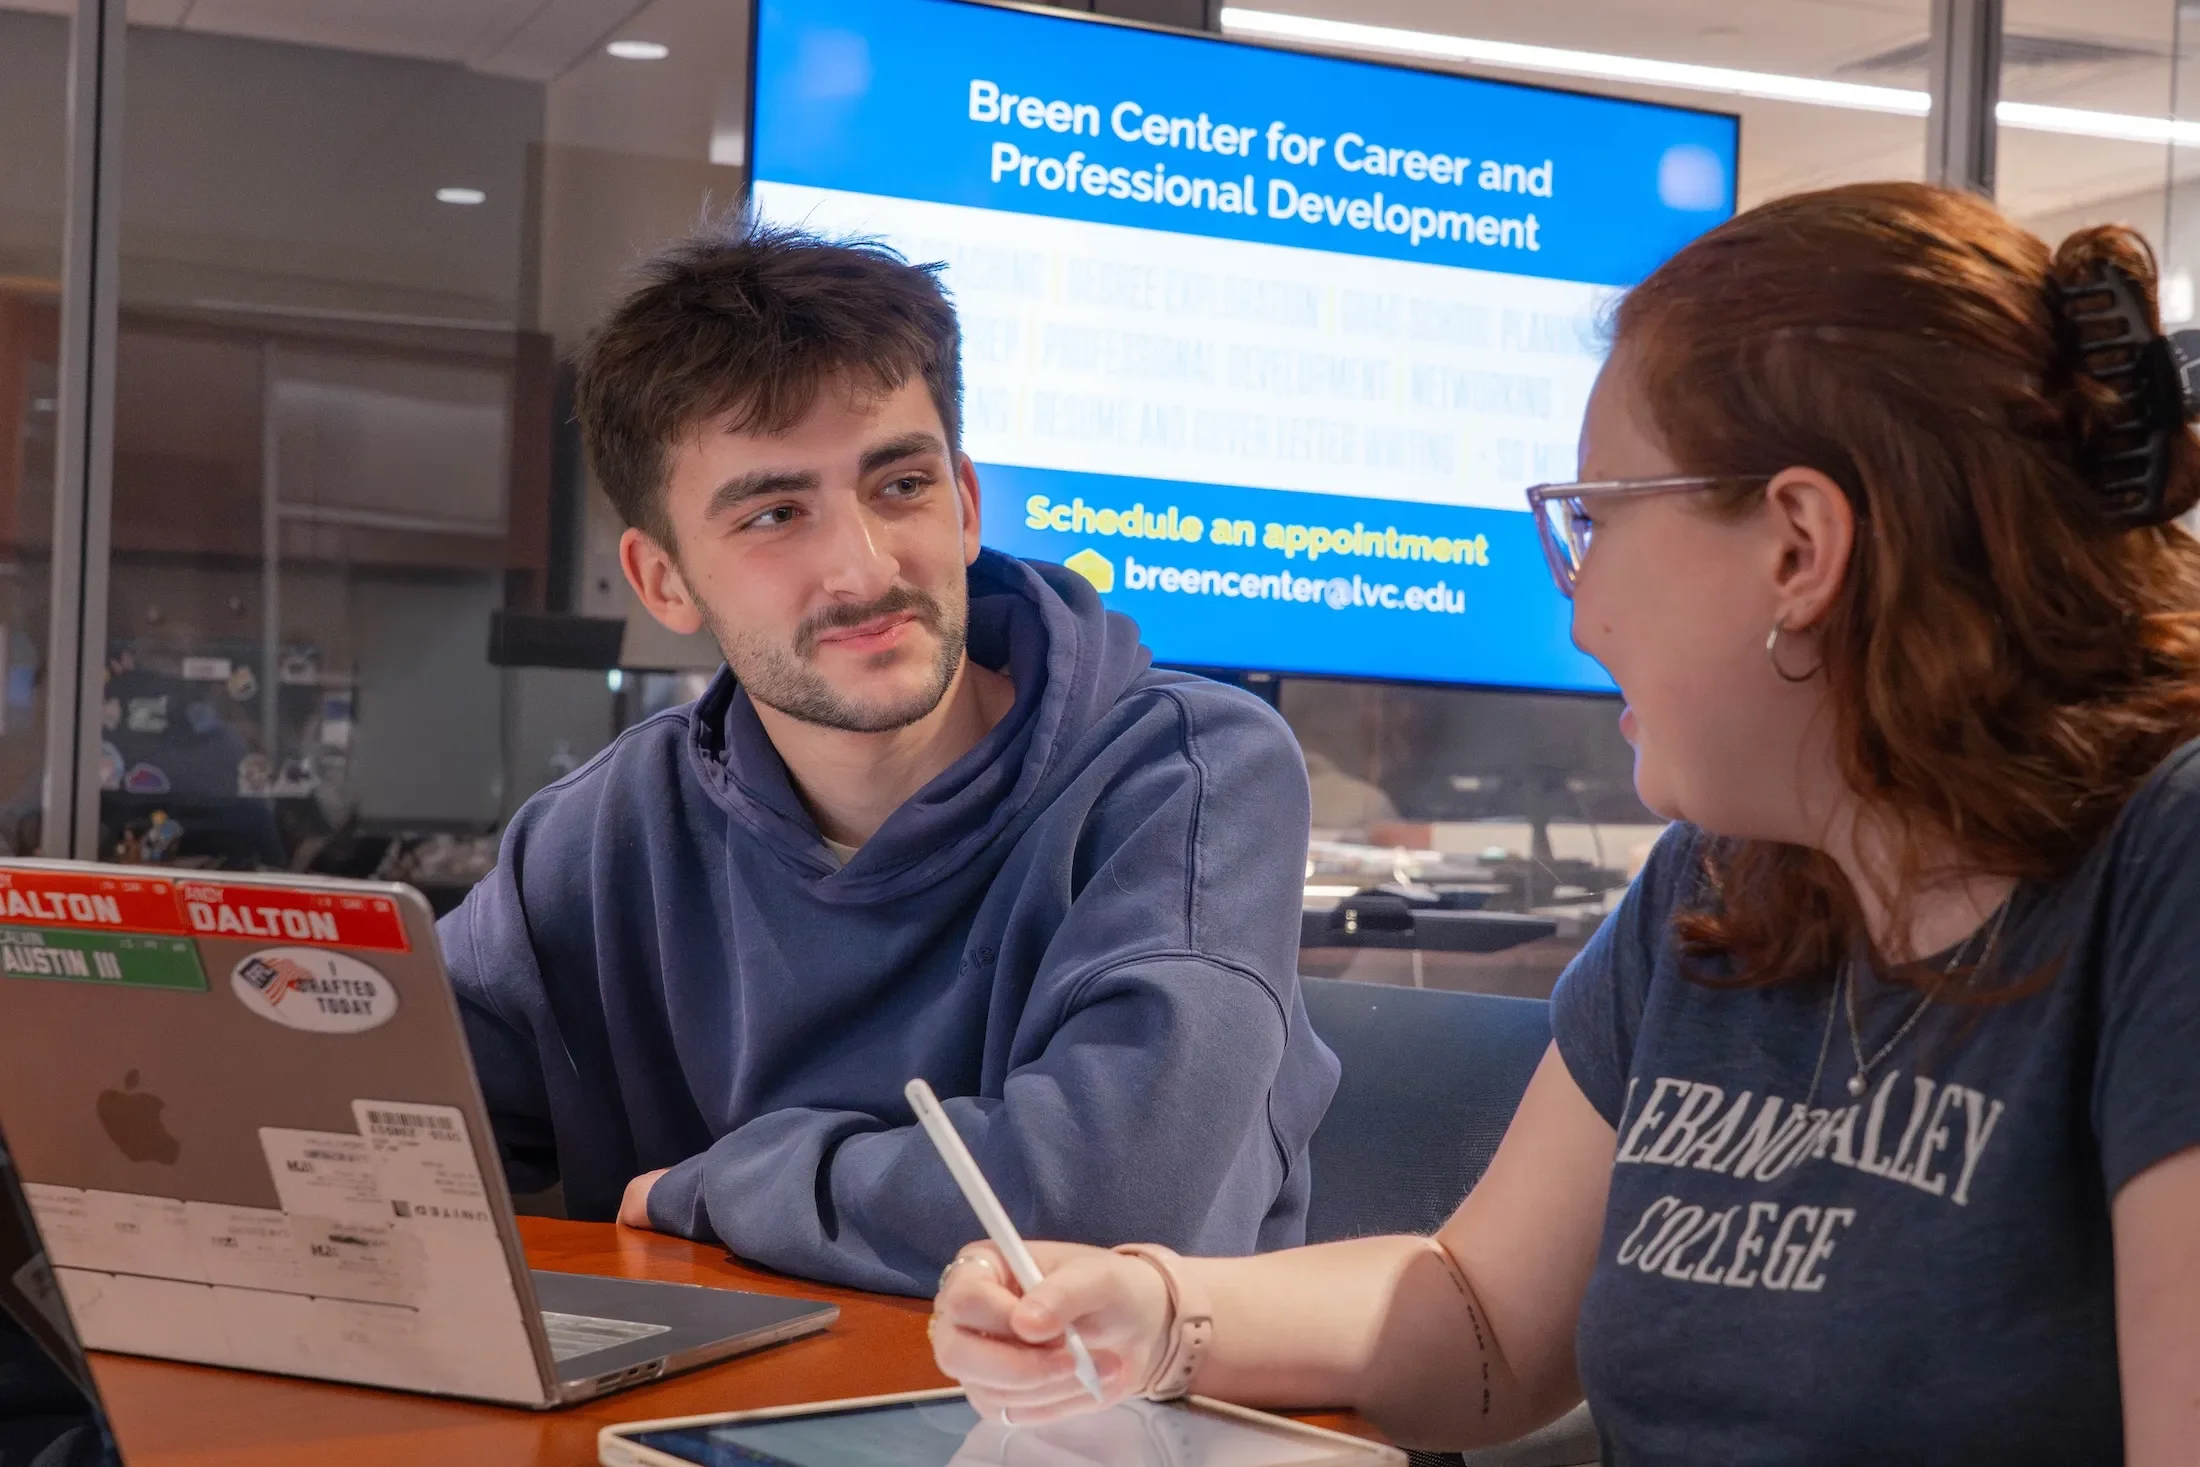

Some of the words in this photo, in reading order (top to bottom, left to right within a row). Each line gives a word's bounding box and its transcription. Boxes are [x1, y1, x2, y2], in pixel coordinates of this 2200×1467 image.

[968, 79, 1100, 136] Breen
[1111, 102, 1257, 157] Center
[1266, 121, 1327, 166] for
[1334, 132, 1471, 186] Career
[1478, 159, 1553, 198] and
[991, 141, 1256, 216] Professional
[1267, 178, 1540, 251] Development
[1025, 494, 1204, 542] Schedule
[1210, 517, 1255, 547] an
[1263, 521, 1489, 567] appointment
[1124, 556, 1466, 613] breencenter@lvc.edu
[190, 902, 340, 941] DALTON
[2, 944, 90, 977] AUSTIN
[316, 996, 374, 1016] TODAY
[413, 1205, 489, 1224] UNITED
[1616, 1195, 1857, 1292] COLLEGE
